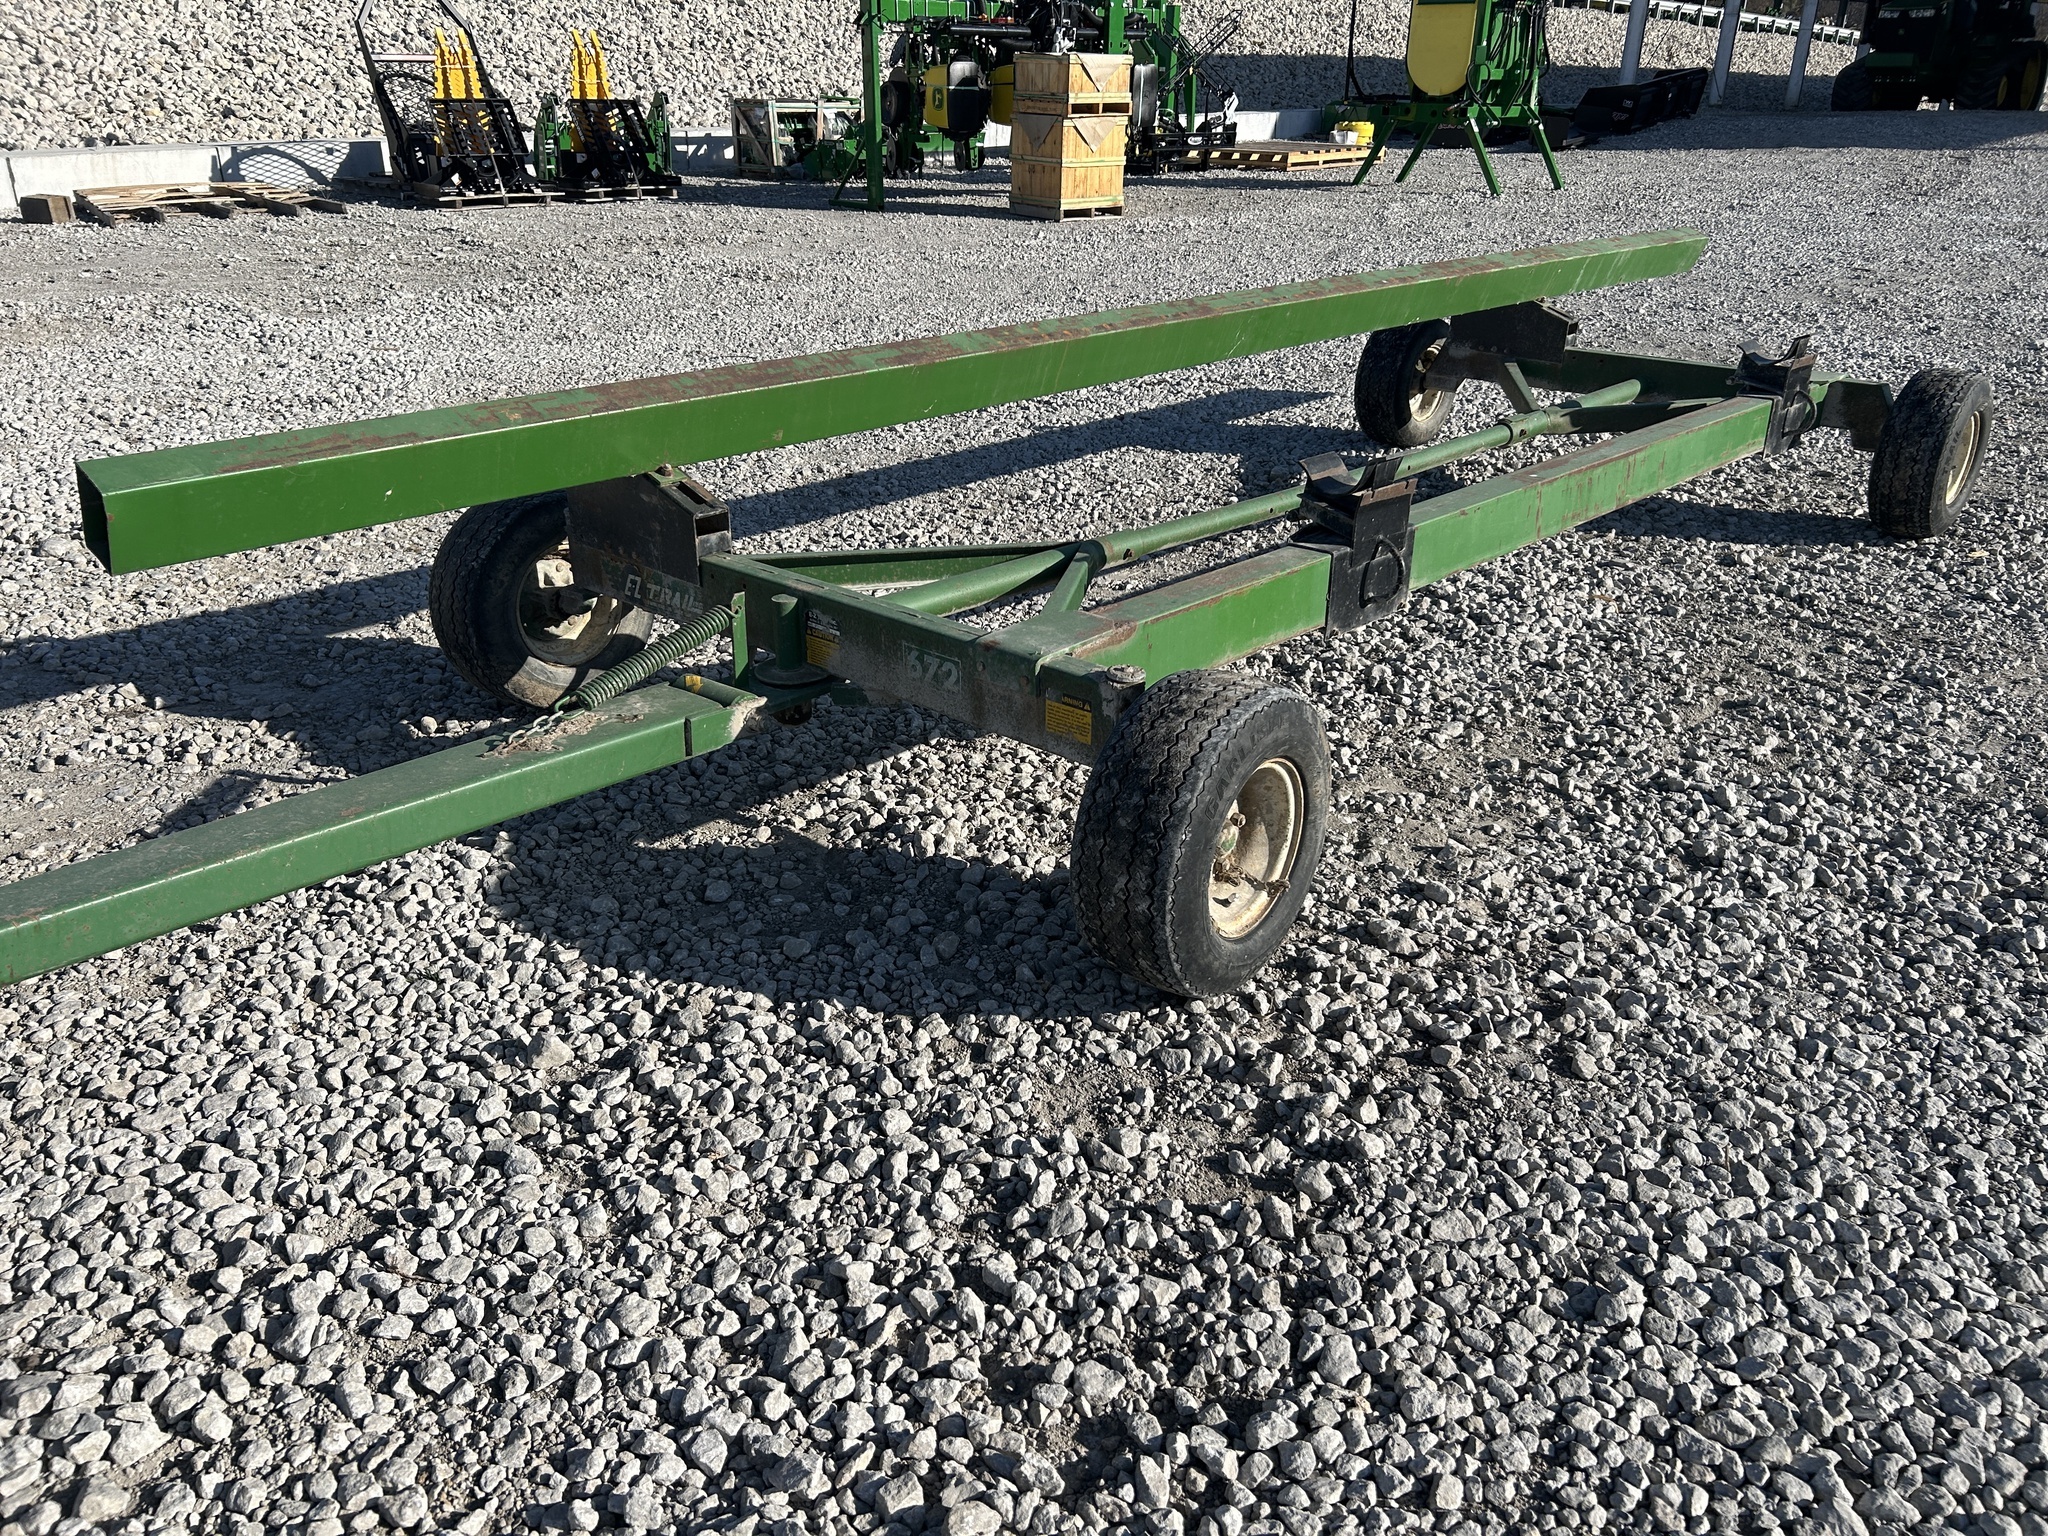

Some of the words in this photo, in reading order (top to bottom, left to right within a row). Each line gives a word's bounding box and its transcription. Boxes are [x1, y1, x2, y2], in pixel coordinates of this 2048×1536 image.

[646, 582, 703, 615] TRAIL
[908, 650, 958, 692] 672
[1061, 695, 1083, 708] ARNING
